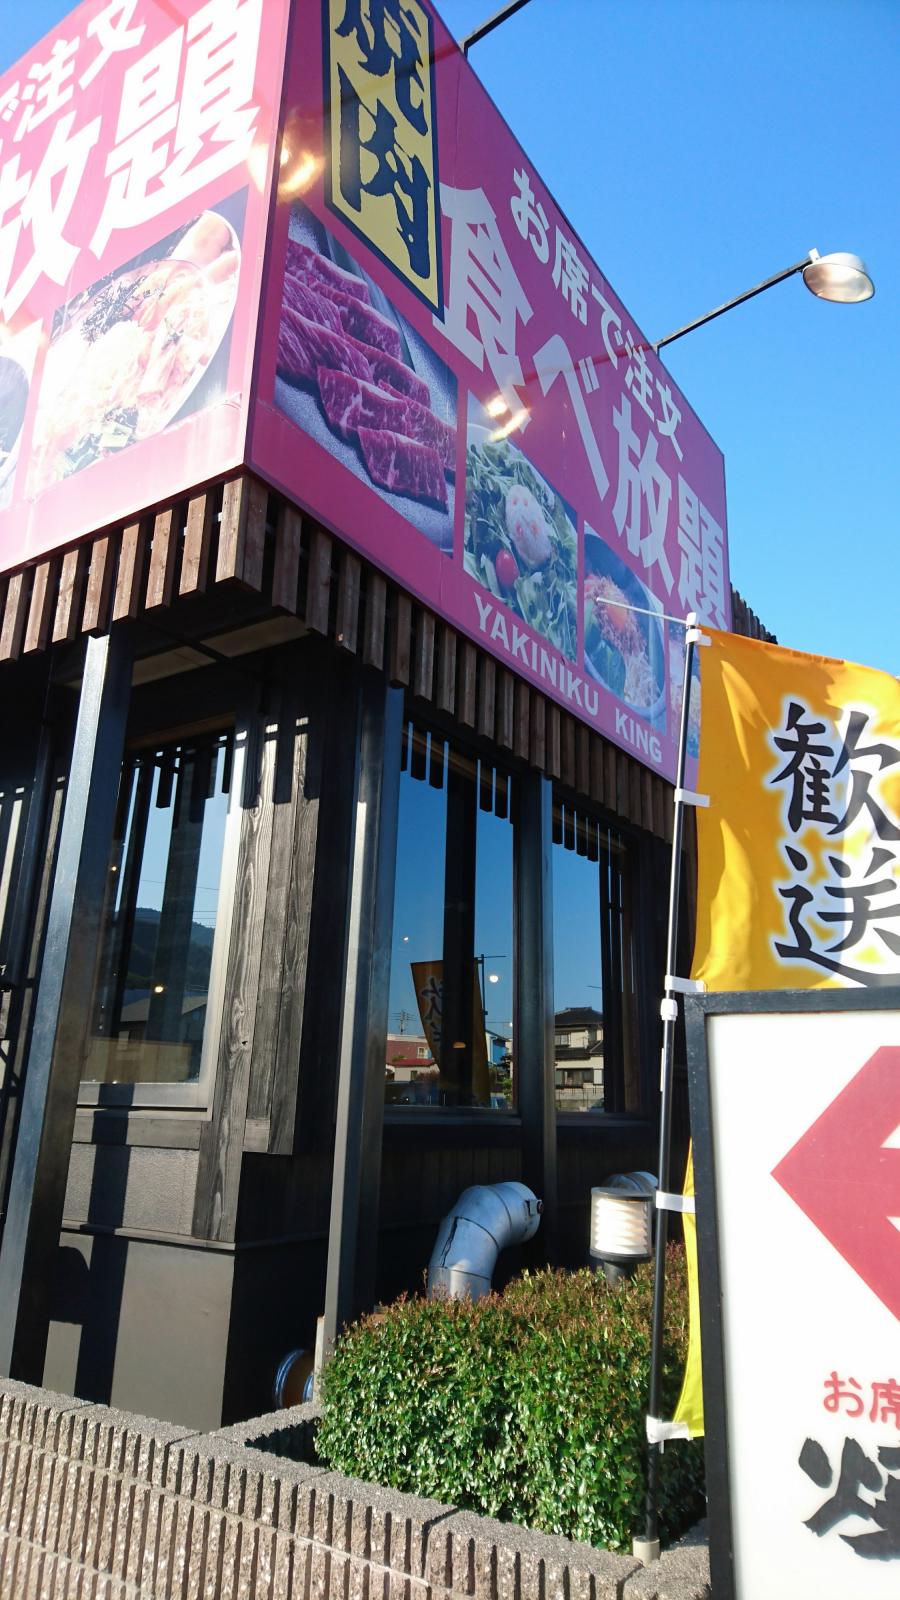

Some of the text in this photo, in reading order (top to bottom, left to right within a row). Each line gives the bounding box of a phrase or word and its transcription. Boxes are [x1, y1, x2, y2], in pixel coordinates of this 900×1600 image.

[432, 183, 729, 632] 食べ放題
[511, 167, 684, 461] お席で注文
[474, 592, 662, 763] YAKINIKU KING
[770, 702, 900, 987] 歓送
